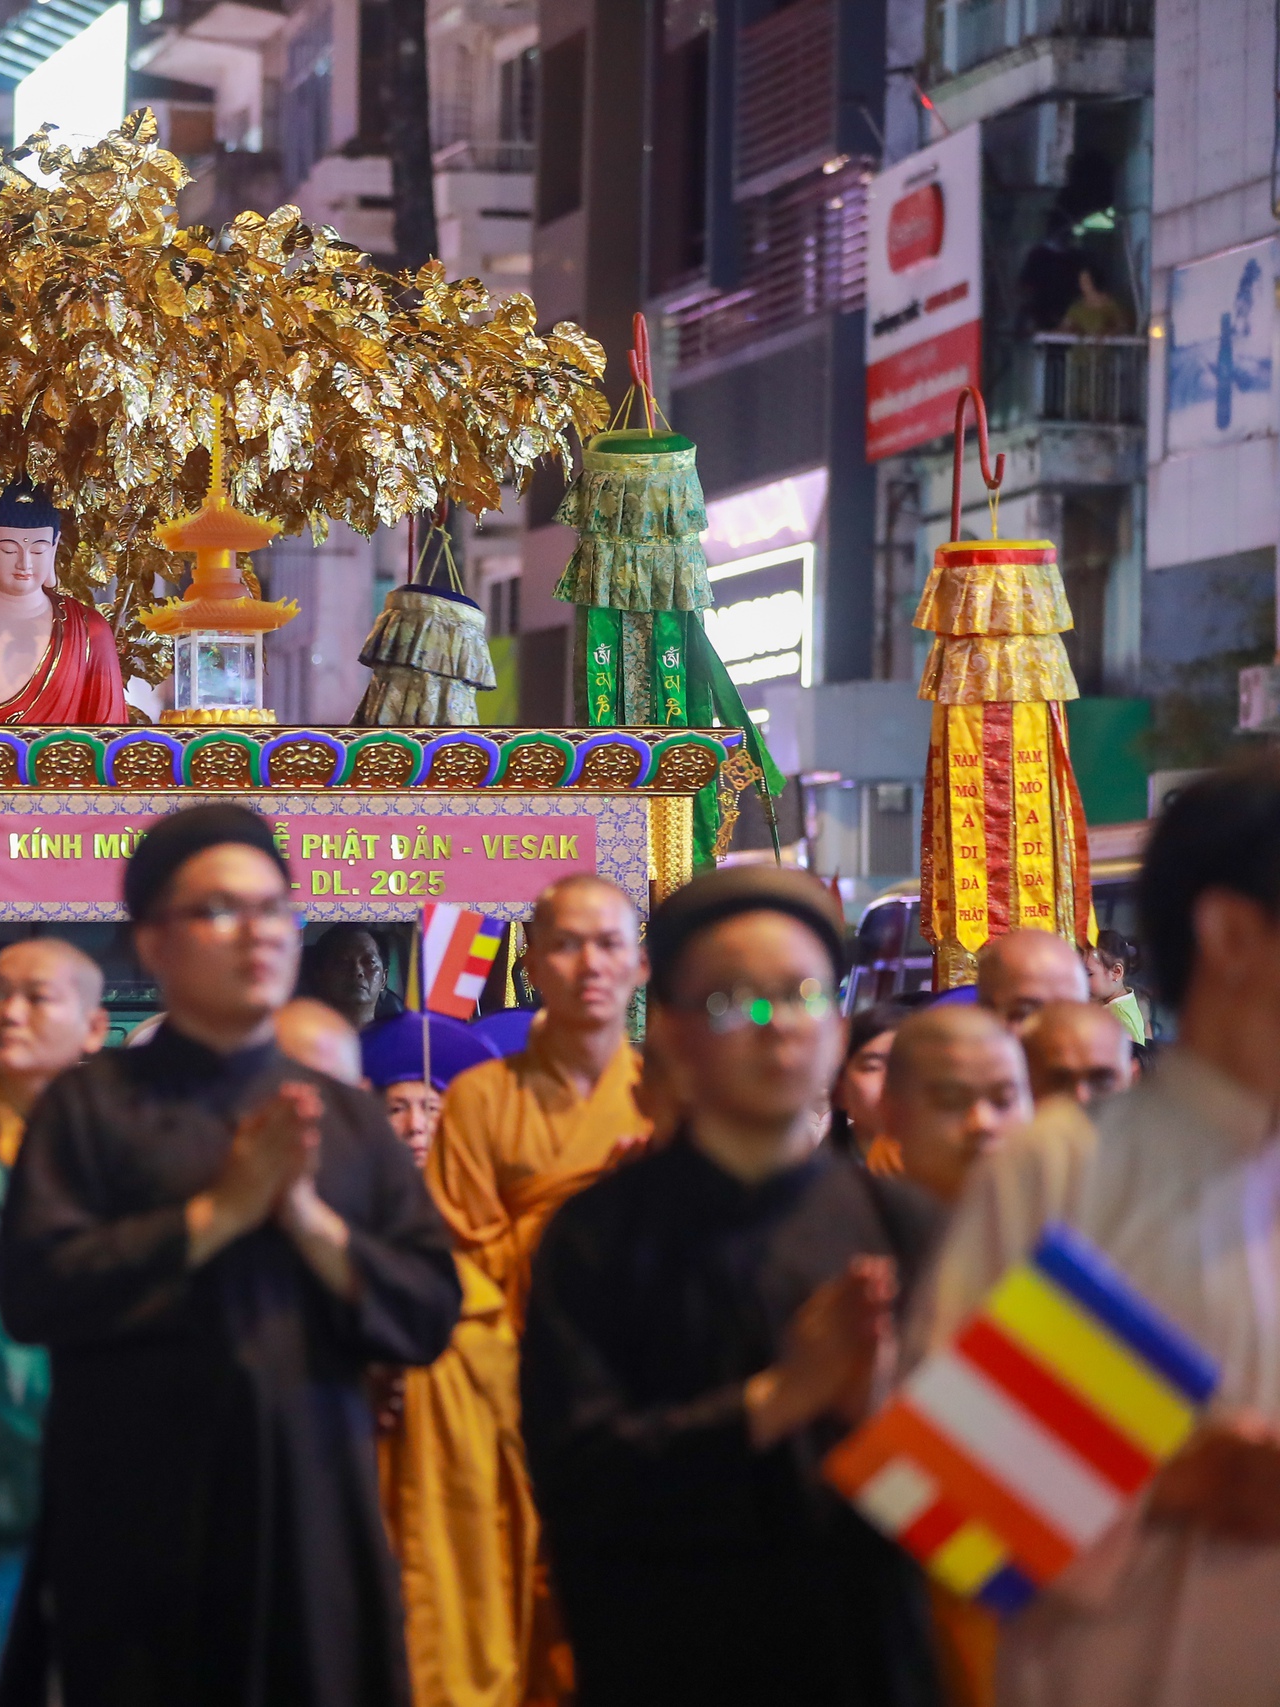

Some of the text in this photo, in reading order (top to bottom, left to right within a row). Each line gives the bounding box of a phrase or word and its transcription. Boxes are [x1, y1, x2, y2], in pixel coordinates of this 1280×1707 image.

[952, 754, 979, 767] NAM
[1017, 750, 1043, 764] NAM
[955, 782, 978, 797] MÔ
[1019, 778, 1043, 793] MÔ
[962, 813, 975, 828] A
[1024, 809, 1039, 825] A
[9, 821, 580, 866] KÍNH MỪ Ễ PHẬT ĐẢN - VESAK
[1022, 842, 1043, 855] DI
[960, 845, 978, 859] DI
[311, 870, 360, 896] DL.
[370, 870, 447, 896] 2025
[961, 874, 980, 890] ĐÀ
[1023, 871, 1045, 887] ĐÀ
